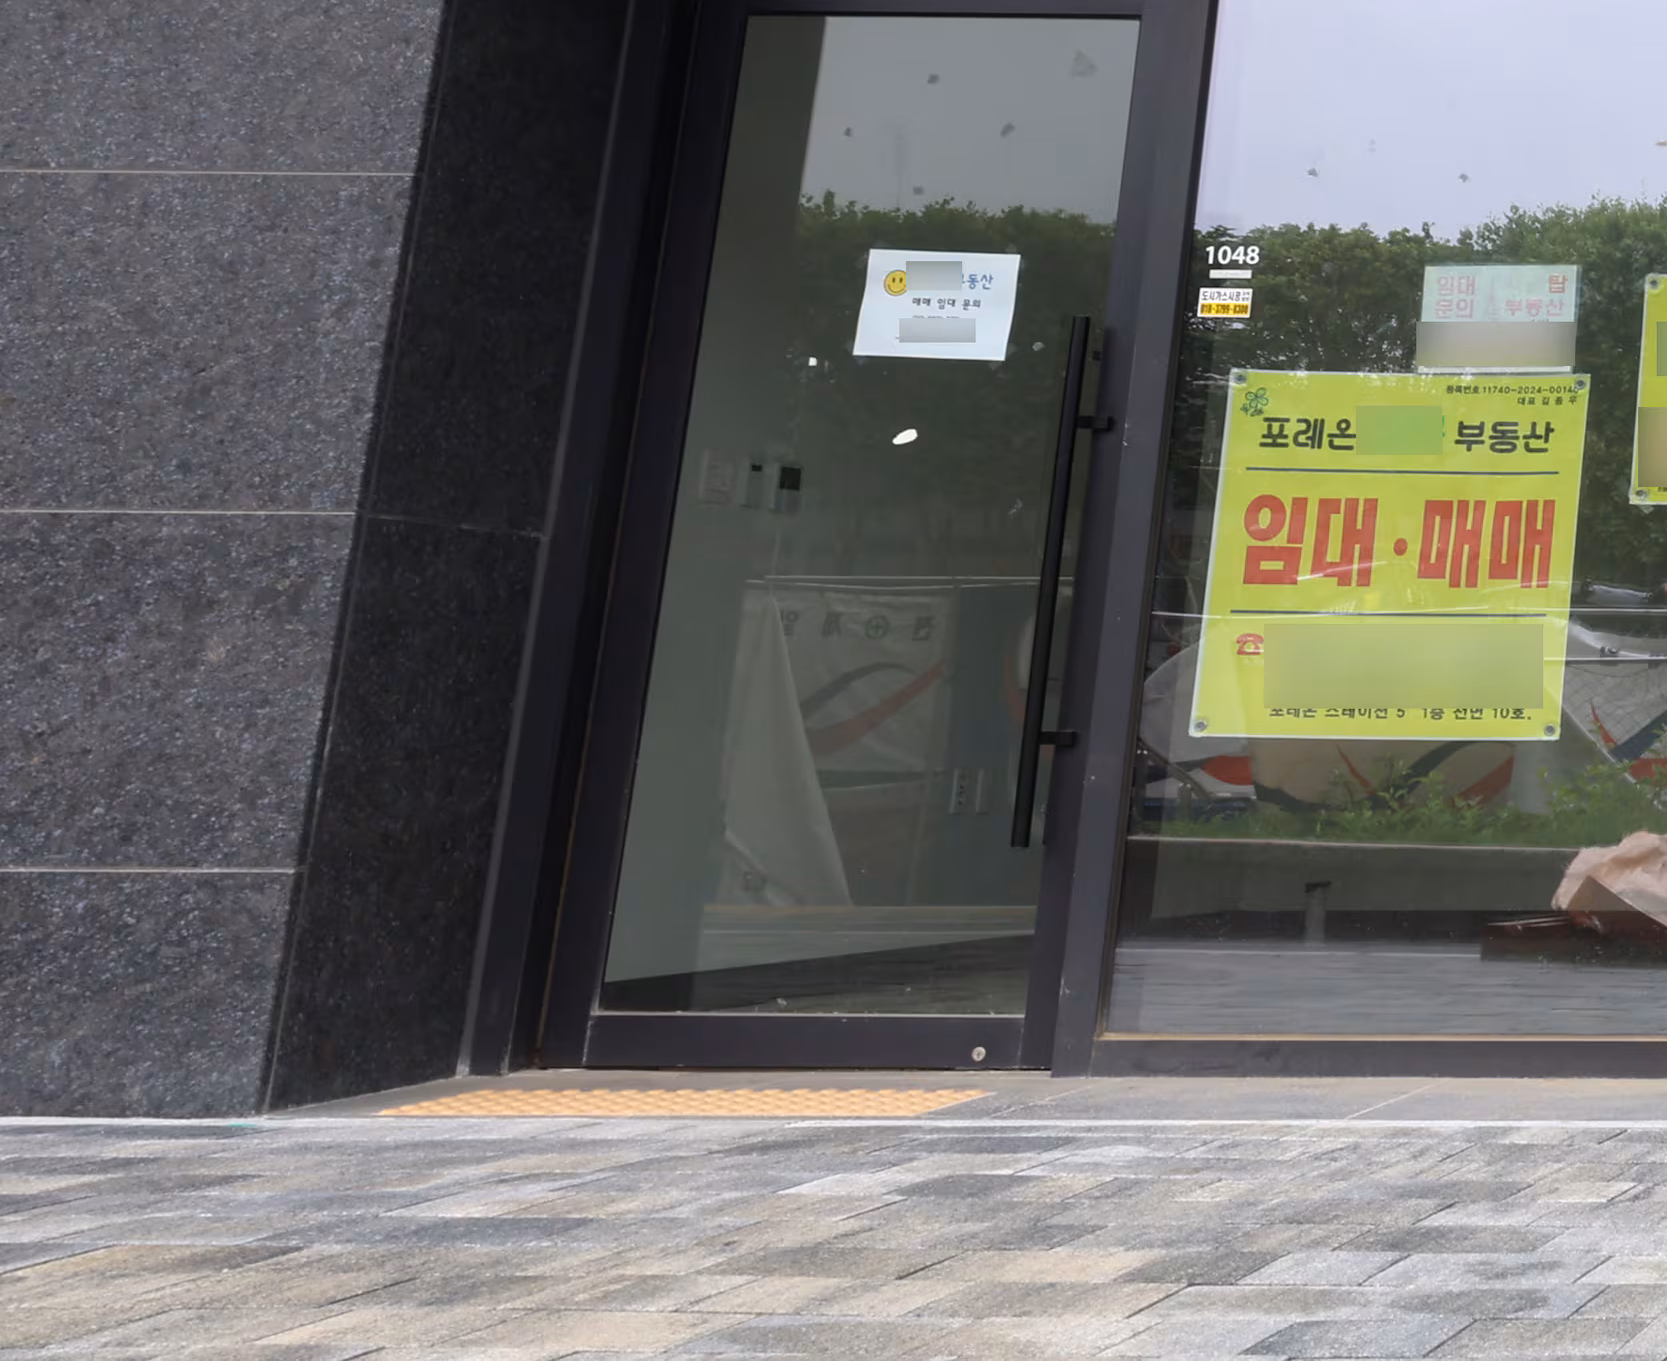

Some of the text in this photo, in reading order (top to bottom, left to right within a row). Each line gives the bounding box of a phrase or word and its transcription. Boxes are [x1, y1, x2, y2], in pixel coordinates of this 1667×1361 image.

[1205, 245, 1260, 265] 1048
[962, 273, 994, 290] 동산
[1436, 274, 1476, 296] 임대
[1548, 273, 1568, 293] 탑
[912, 297, 932, 307] 매매
[936, 297, 956, 310] 임대
[1435, 298, 1474, 319] 문의
[1504, 299, 1565, 317] 부동산
[1259, 416, 1555, 454] 포레온 부동산
